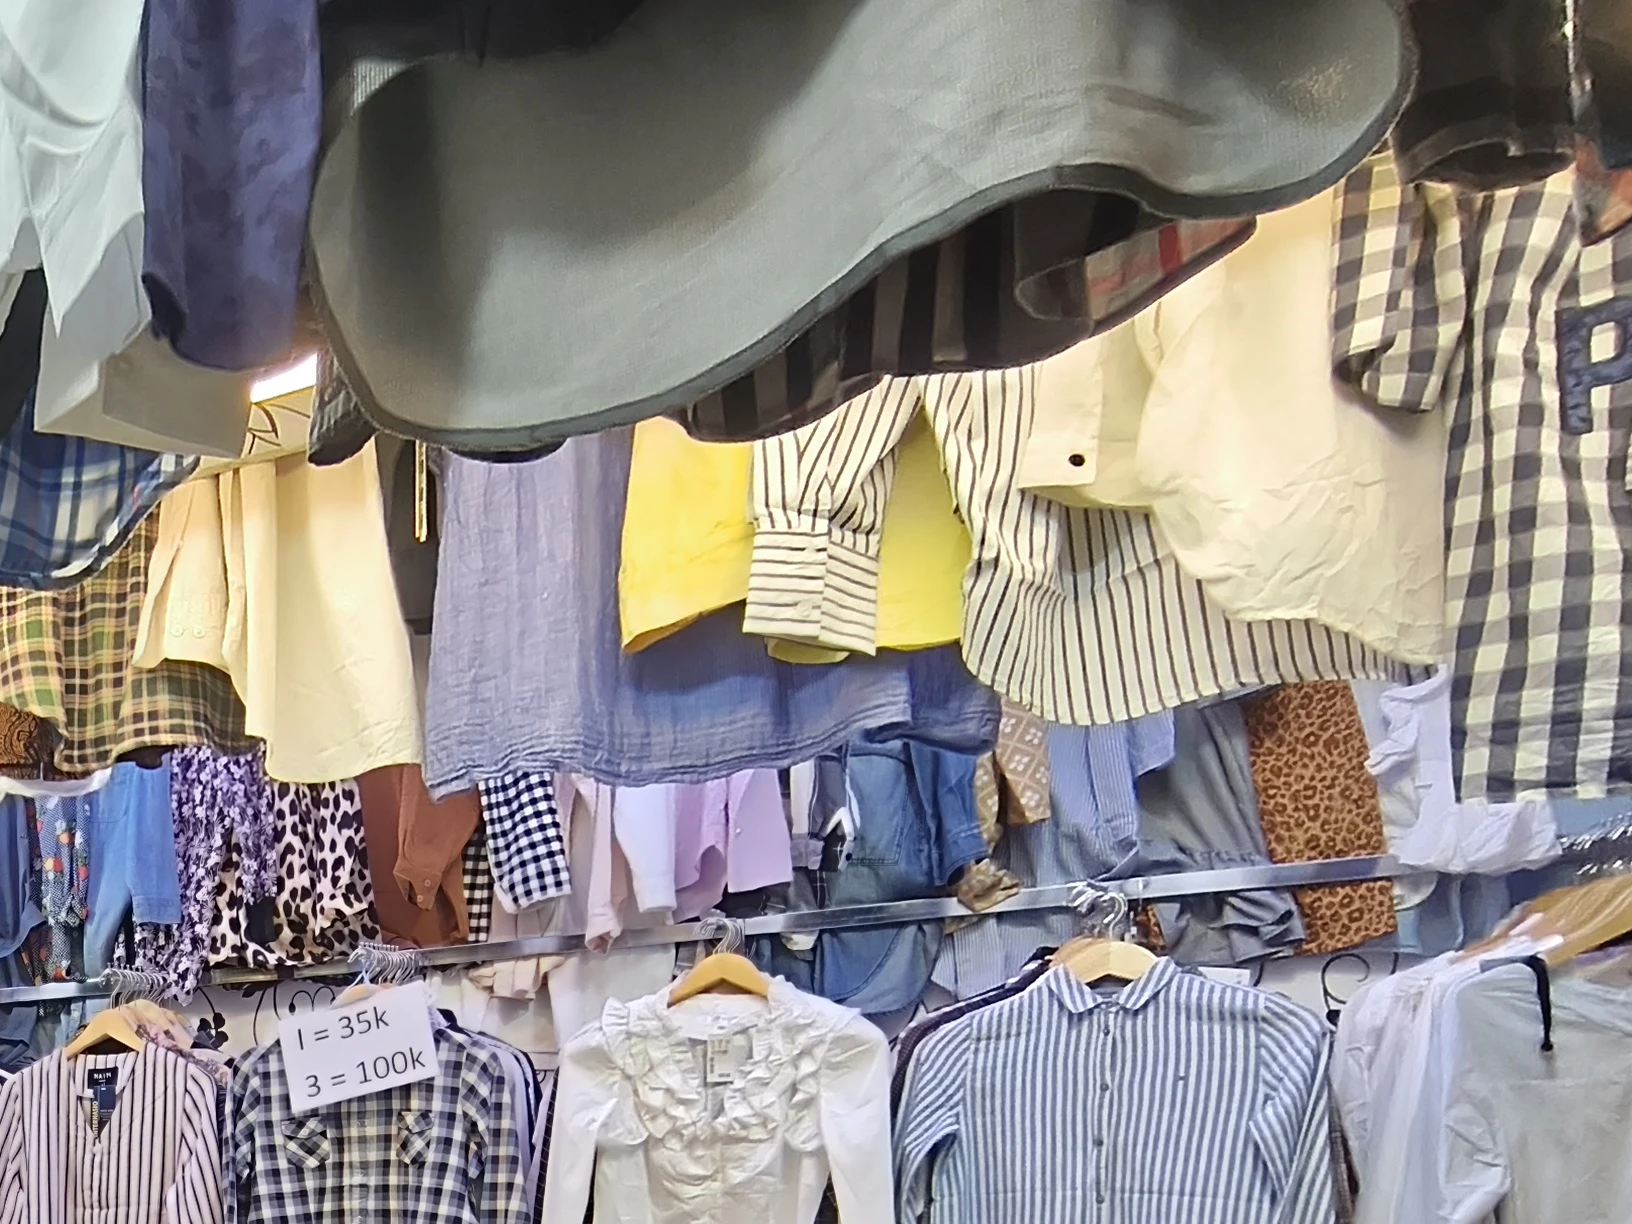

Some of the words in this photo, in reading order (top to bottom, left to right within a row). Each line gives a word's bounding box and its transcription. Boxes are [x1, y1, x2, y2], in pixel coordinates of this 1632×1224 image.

[338, 1006, 389, 1039] 35k
[305, 1074, 321, 1098] 3
[356, 1047, 426, 1085] 100k
